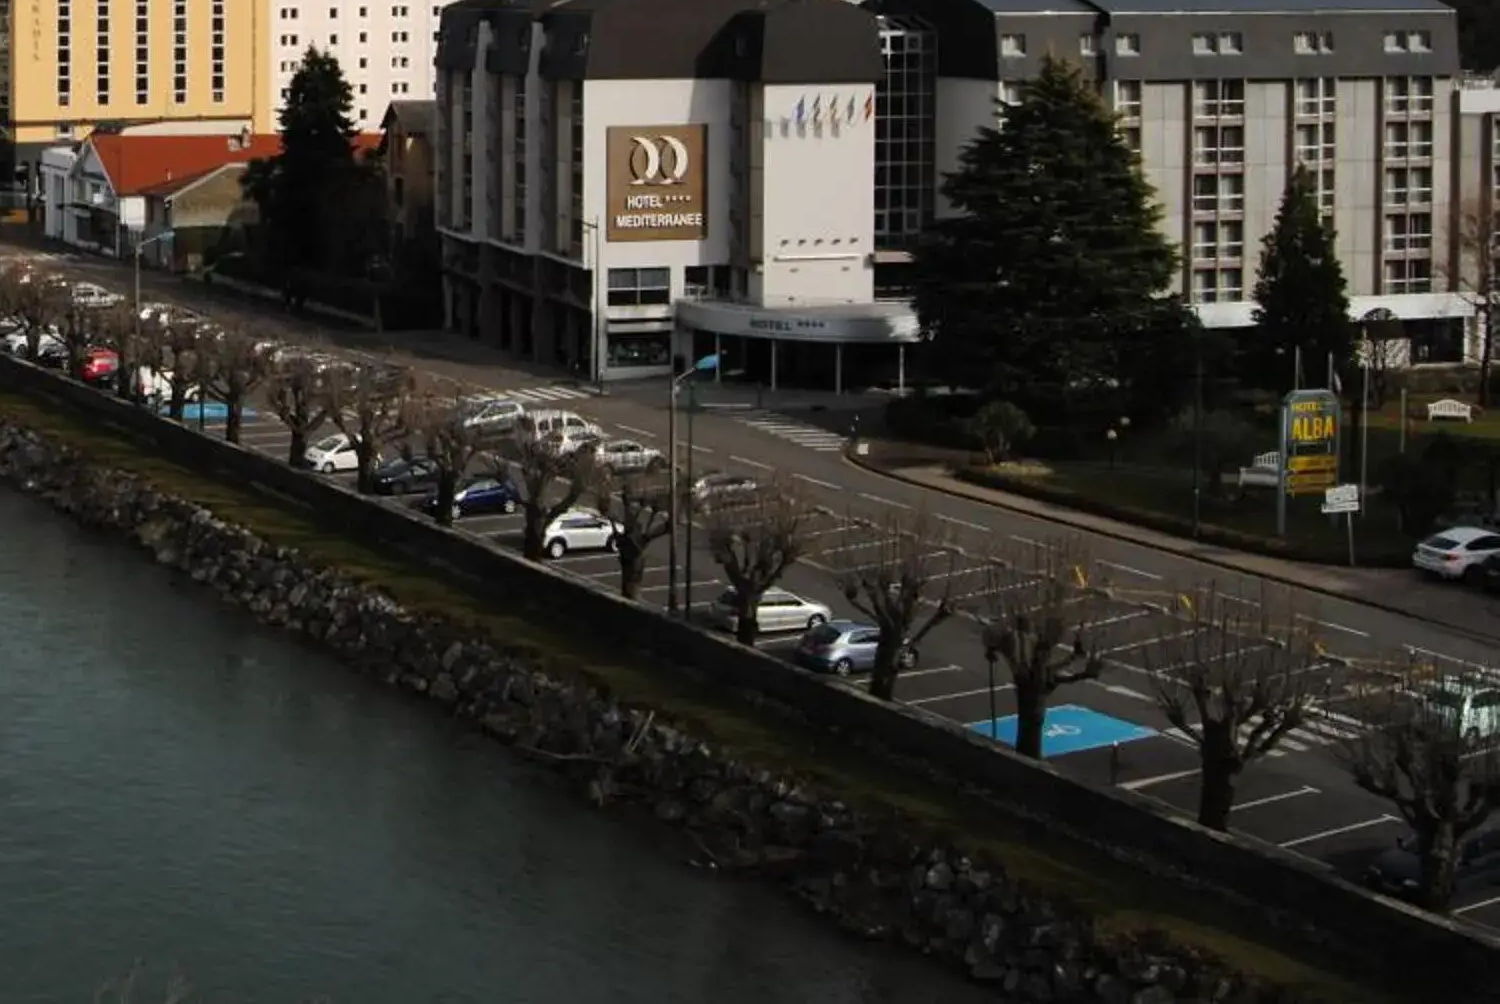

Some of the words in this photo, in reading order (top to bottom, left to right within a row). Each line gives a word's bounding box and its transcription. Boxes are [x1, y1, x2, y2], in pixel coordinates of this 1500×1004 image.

[626, 195, 663, 208] HOTEL
[615, 213, 703, 227] MEDITERRANEE
[1291, 416, 1334, 440] ALBA
